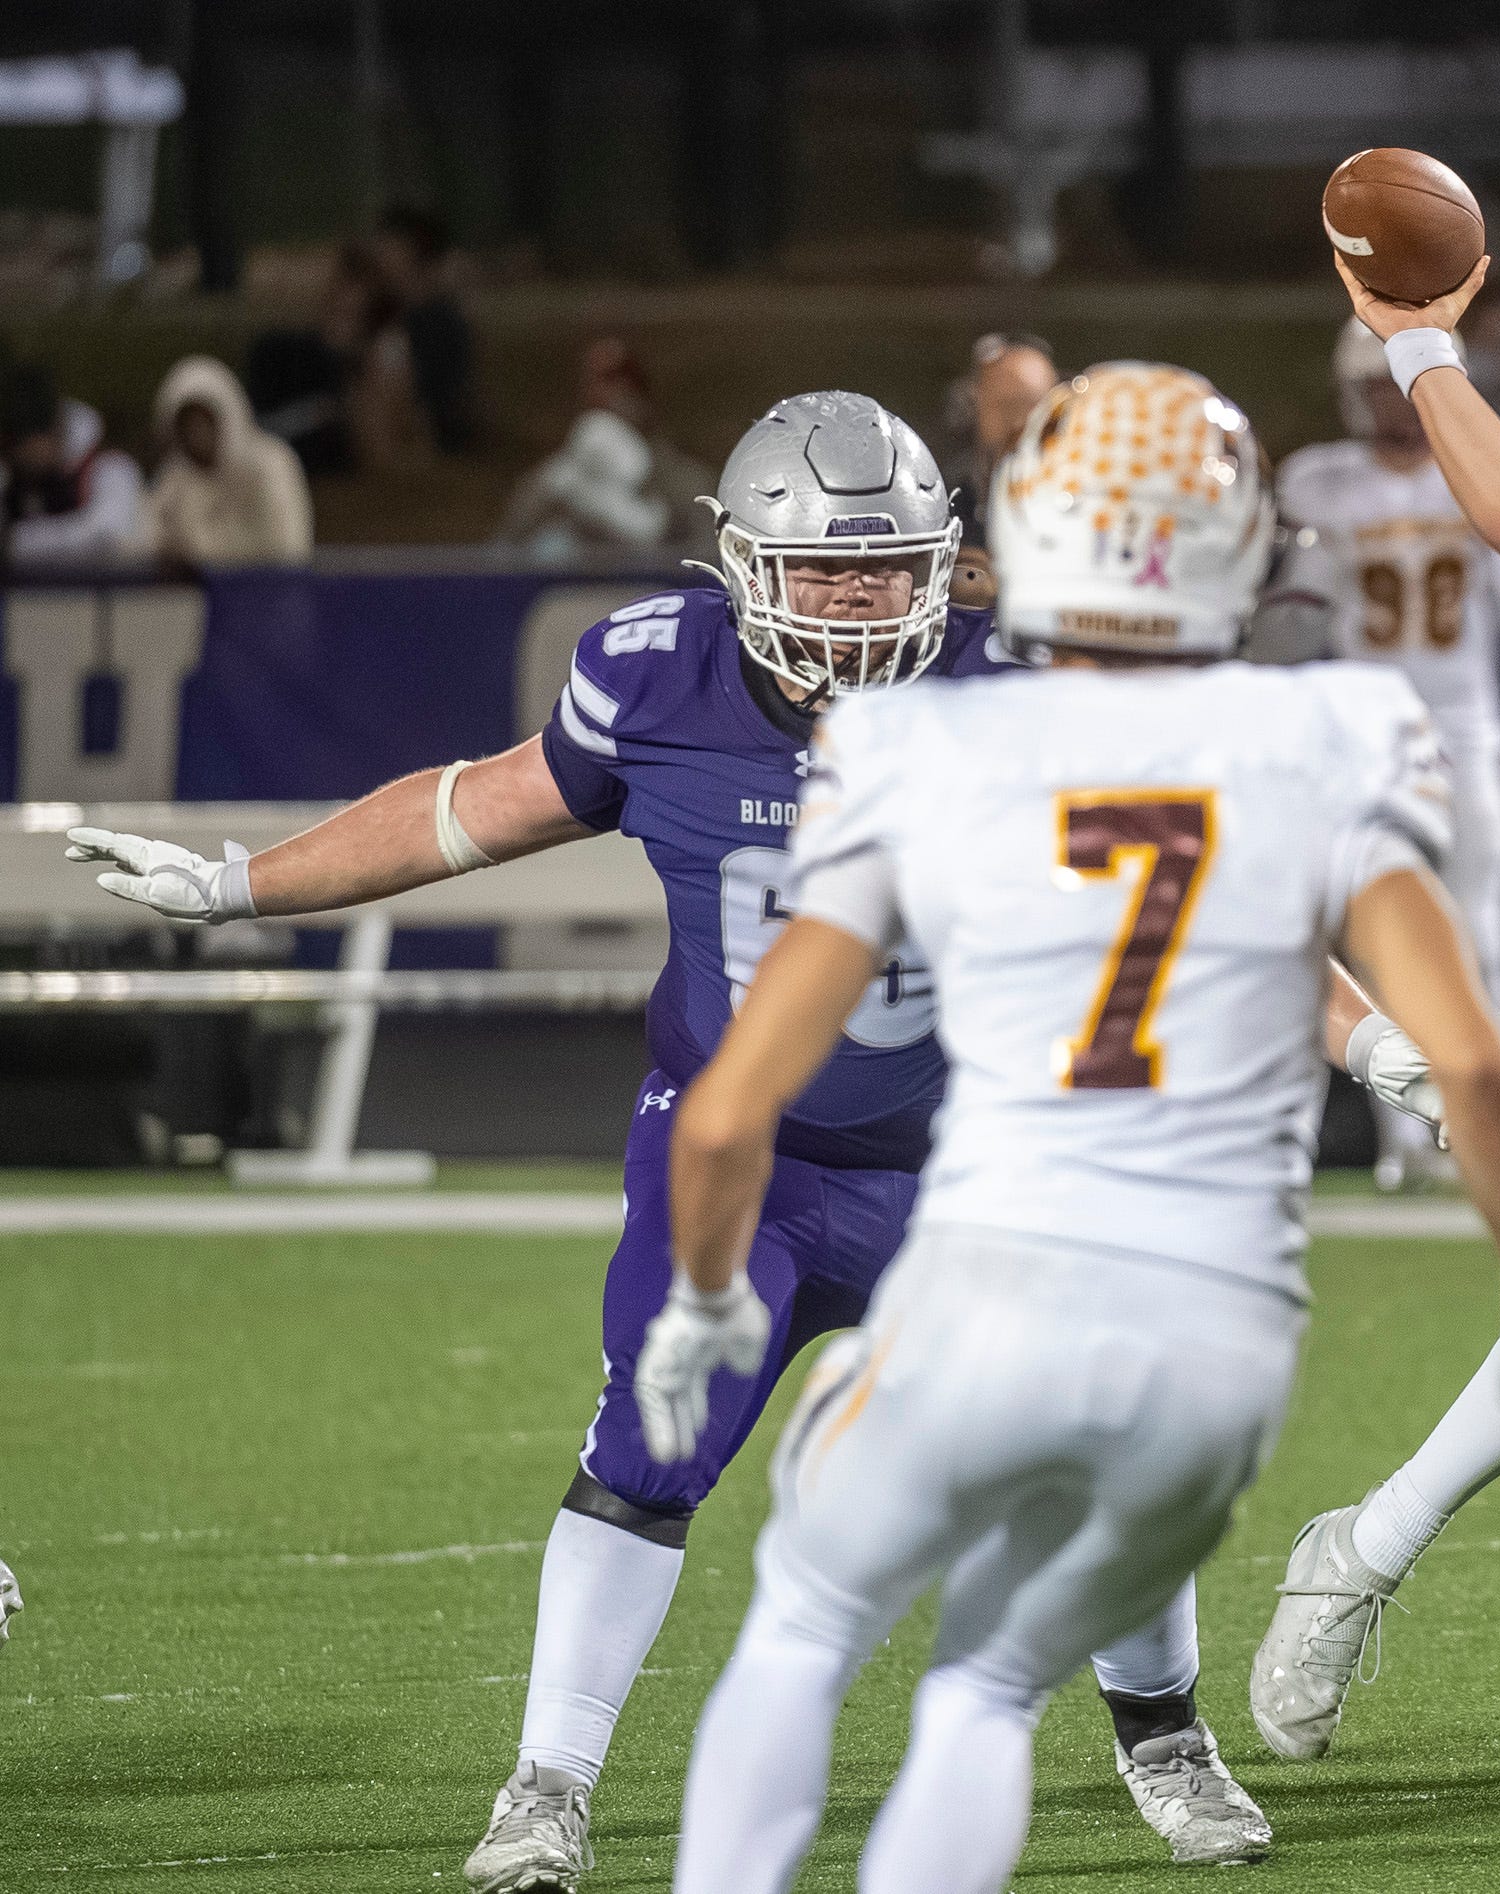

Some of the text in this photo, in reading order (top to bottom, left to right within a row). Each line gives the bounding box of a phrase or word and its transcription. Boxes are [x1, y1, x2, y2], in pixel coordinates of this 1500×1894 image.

[602, 595, 685, 656] 65
[740, 799, 798, 826] BLOO
[1053, 789, 1220, 1089] 7
